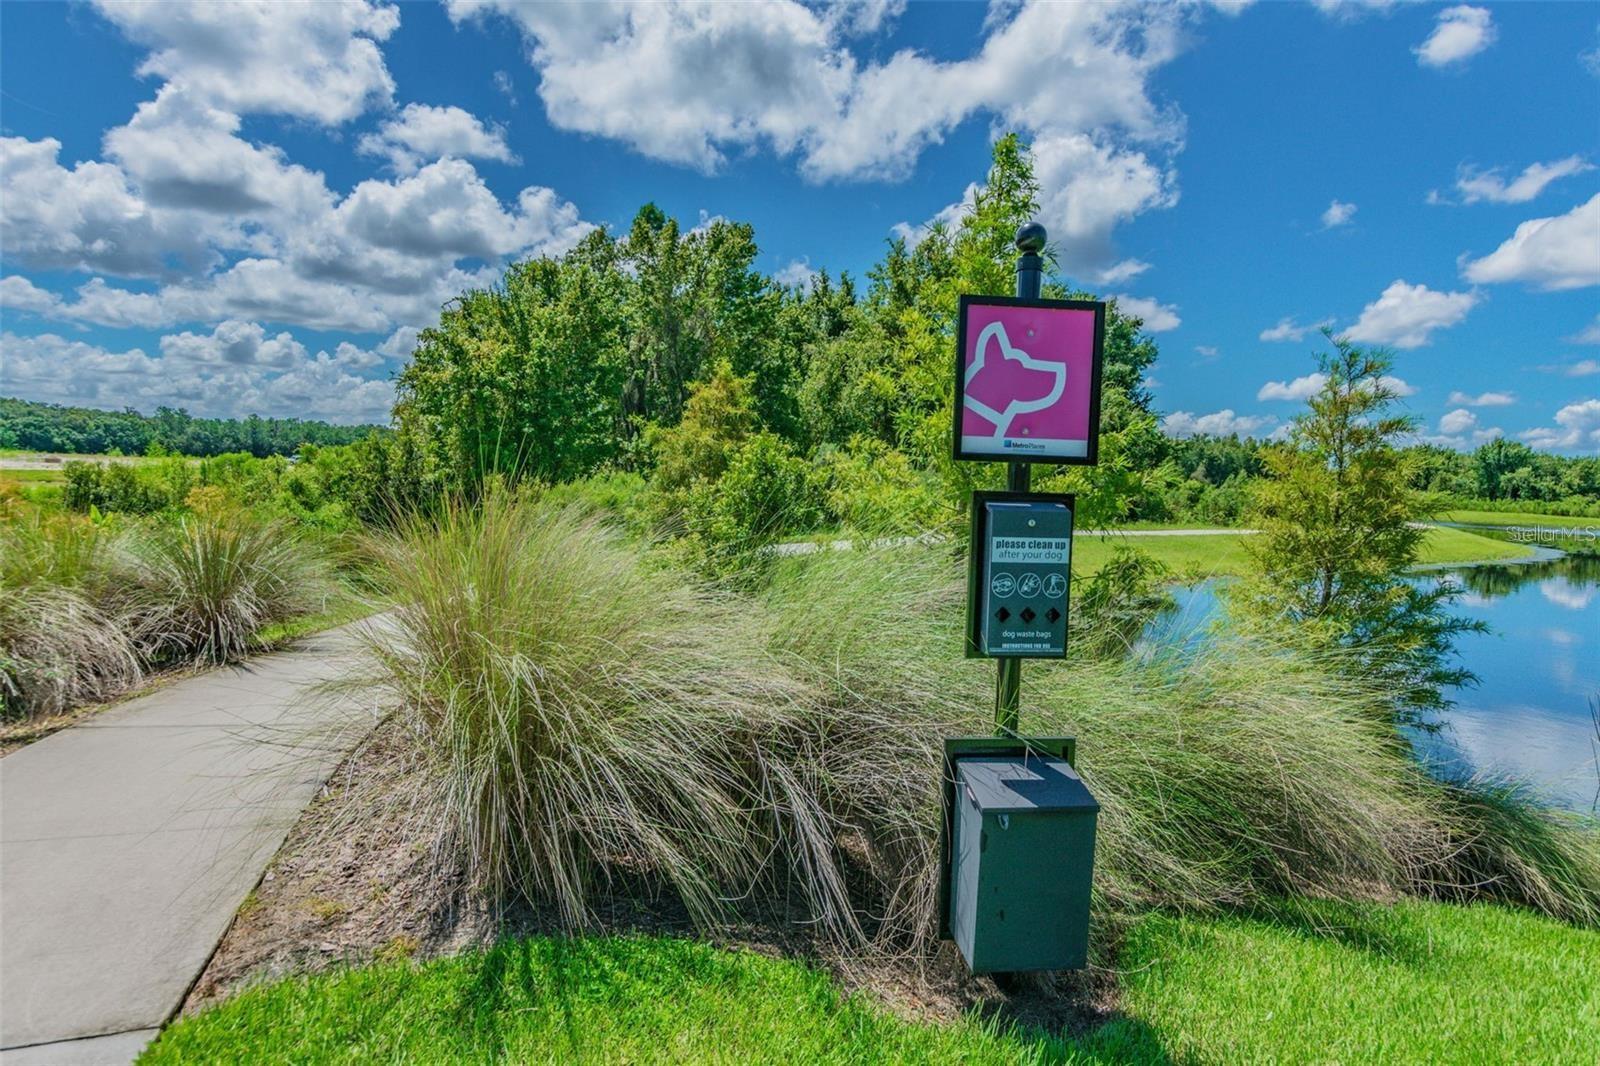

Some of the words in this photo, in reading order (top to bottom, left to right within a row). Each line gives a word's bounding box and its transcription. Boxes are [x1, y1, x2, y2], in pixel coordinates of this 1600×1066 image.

[995, 540, 1026, 550] please
[1028, 540, 1053, 550] clean
[1054, 541, 1066, 551] up
[998, 550, 1020, 559] after
[1022, 552, 1042, 561] your
[1044, 551, 1063, 562] dog
[1002, 629, 1016, 640] dog
[1035, 630, 1052, 640] bags
